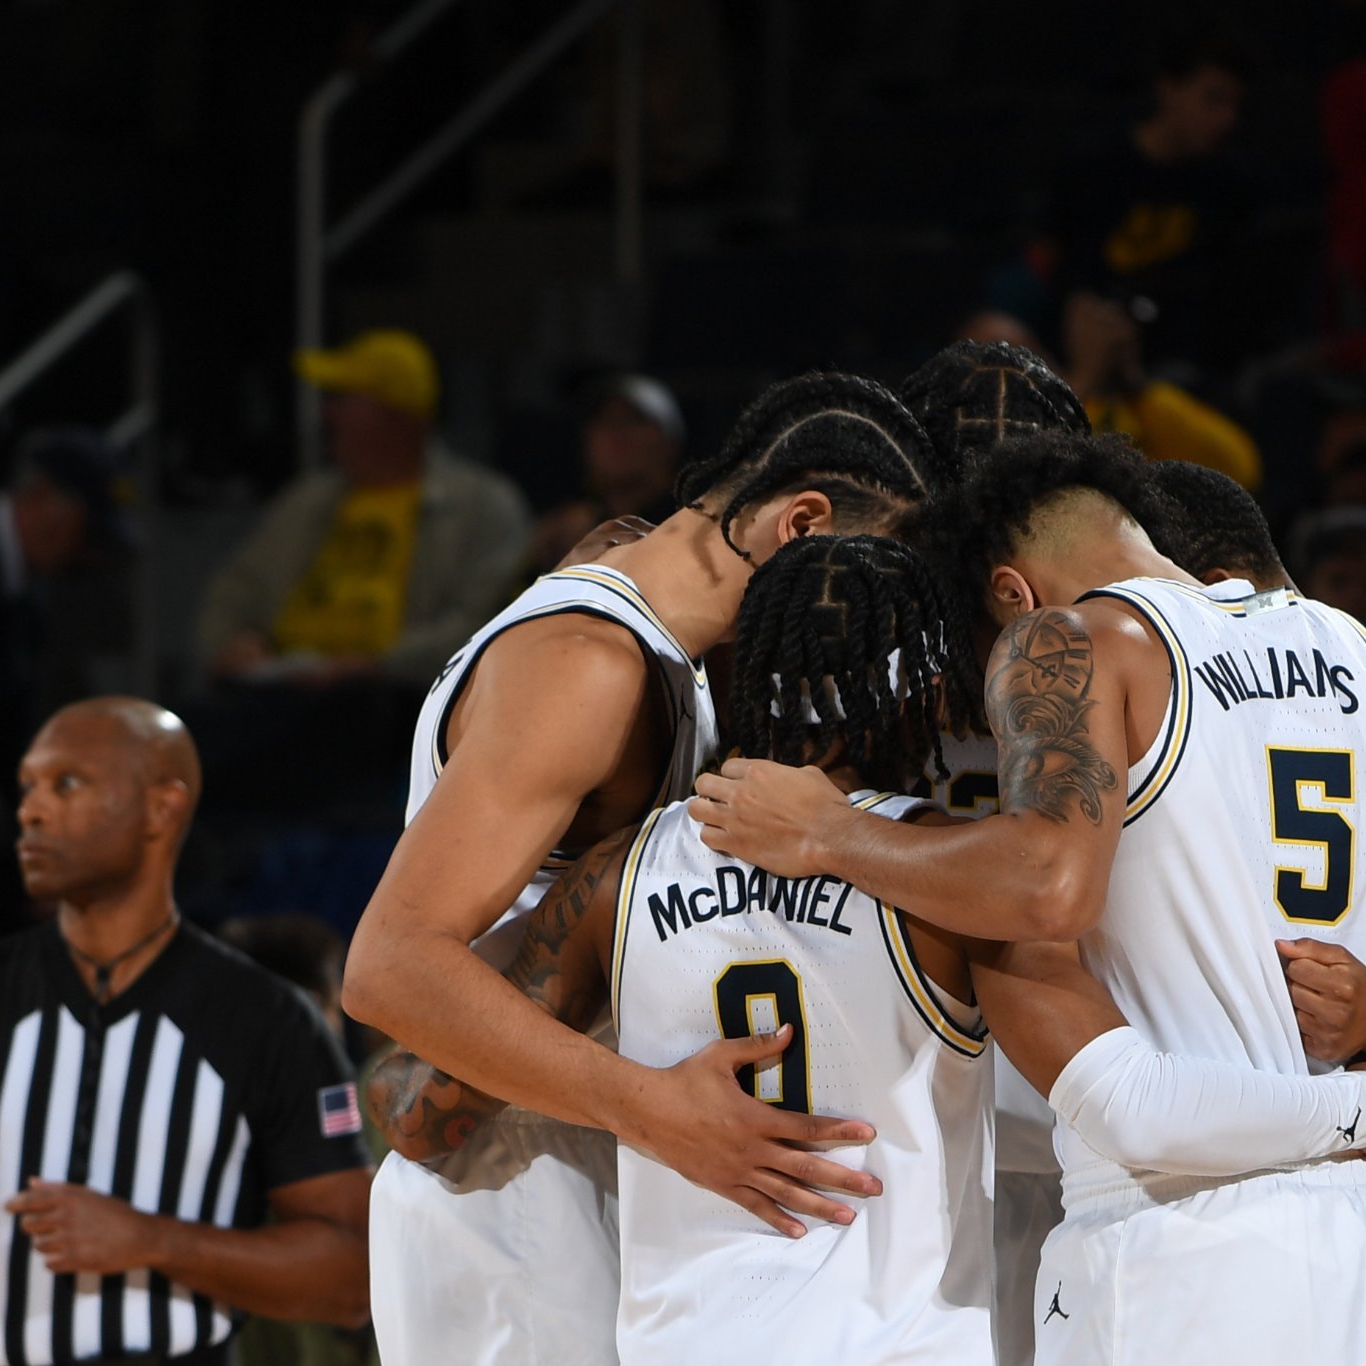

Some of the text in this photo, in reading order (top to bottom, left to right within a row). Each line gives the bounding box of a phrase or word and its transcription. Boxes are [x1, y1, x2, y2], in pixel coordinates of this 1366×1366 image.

[1193, 647, 1359, 715] WILLIAMS
[1266, 745, 1355, 927] 5
[647, 865, 853, 942] McDANIEL
